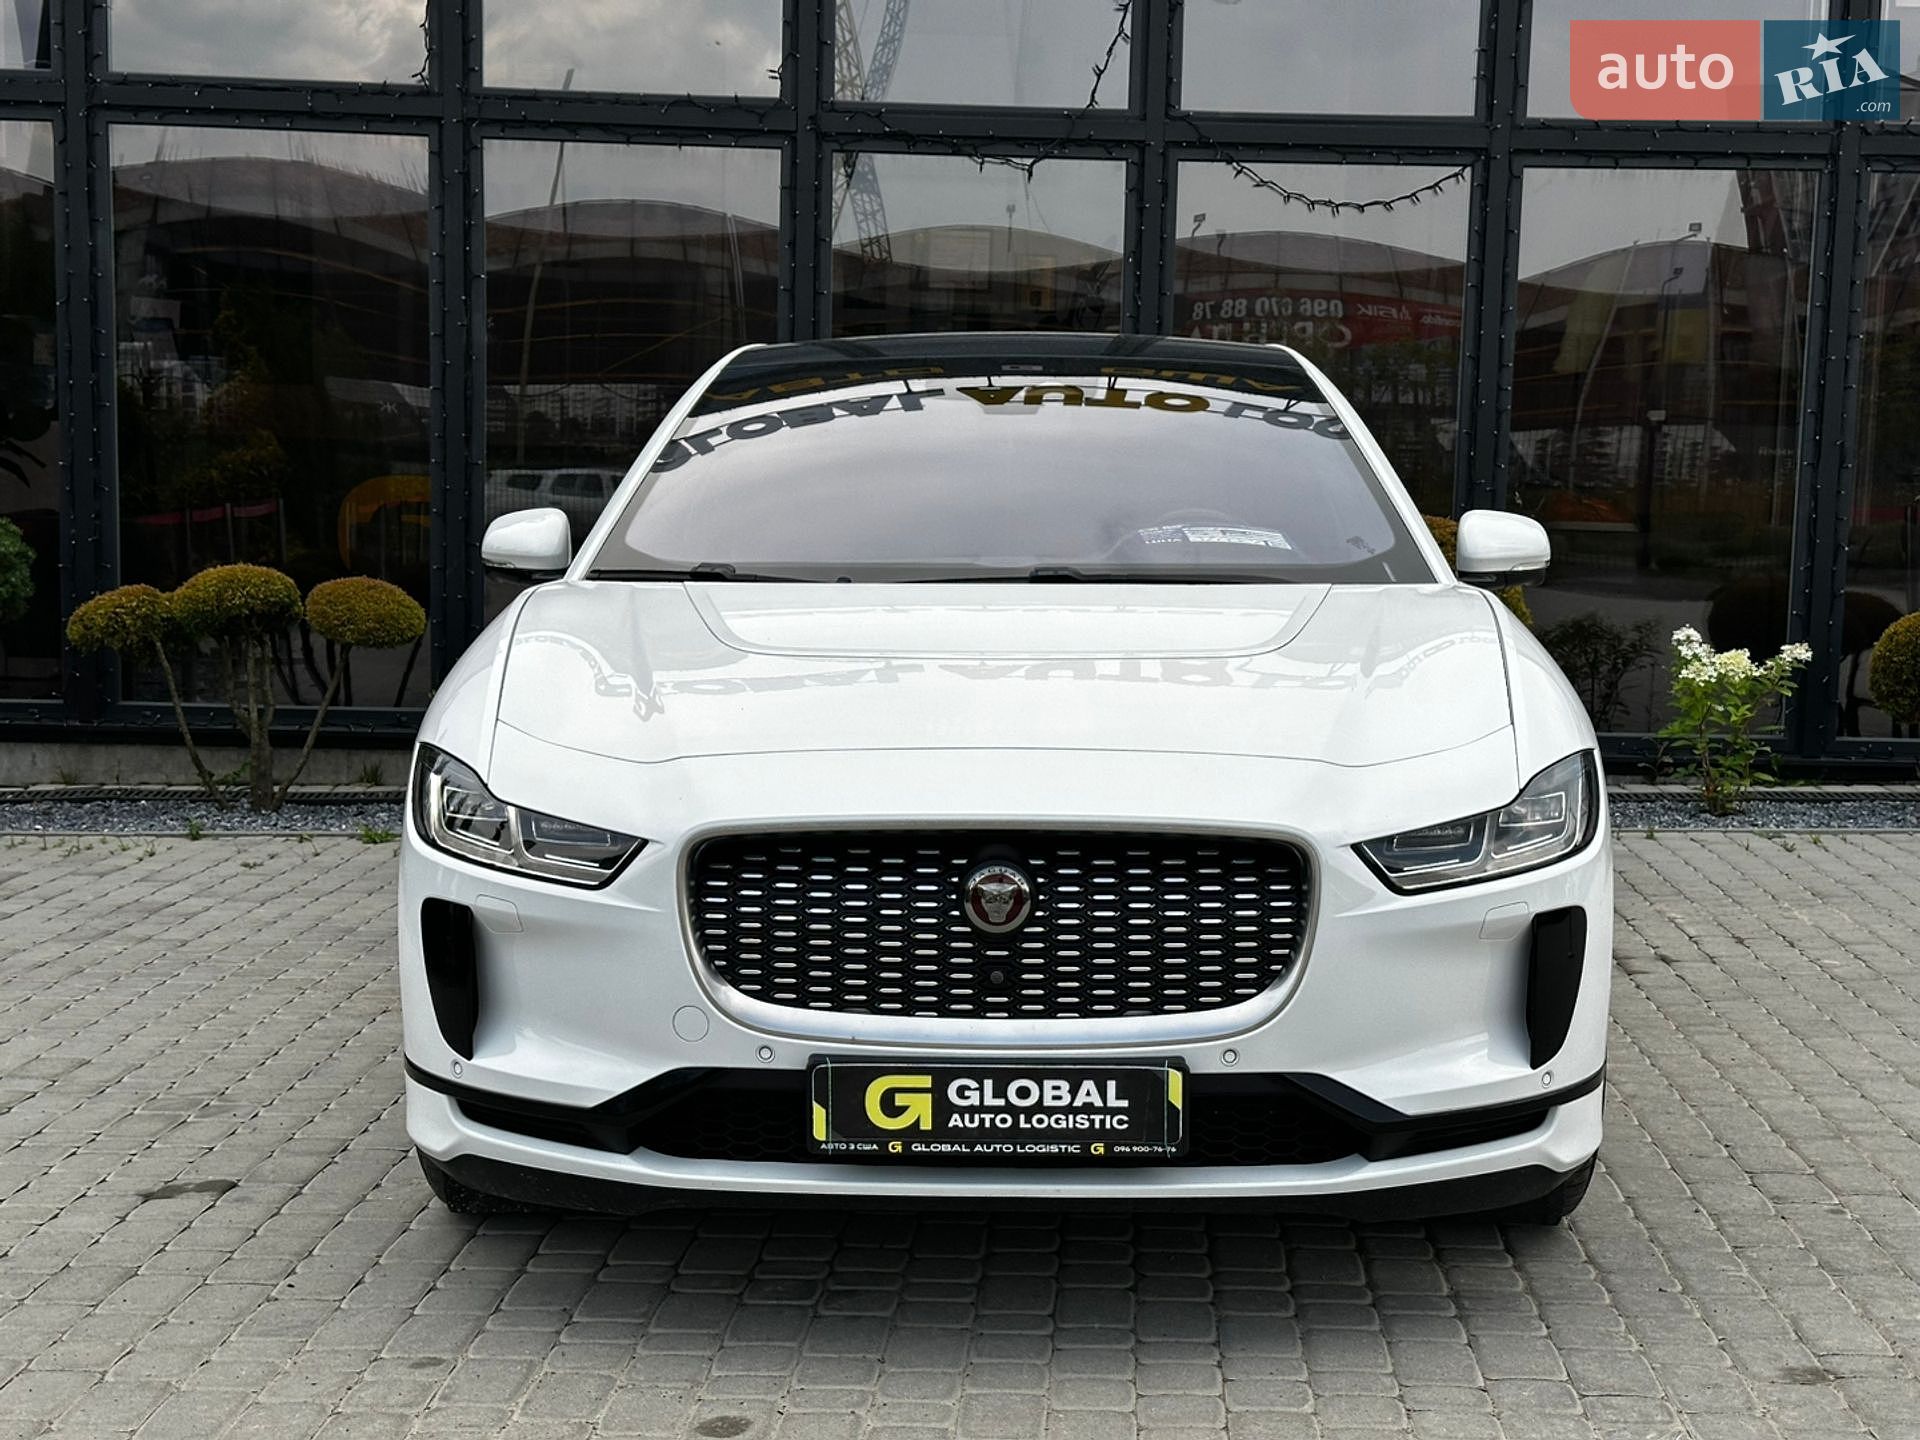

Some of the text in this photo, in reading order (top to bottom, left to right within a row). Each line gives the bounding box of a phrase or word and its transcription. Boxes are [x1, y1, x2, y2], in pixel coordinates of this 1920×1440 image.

[946, 1077, 1129, 1108] GLOBAL
[947, 1113, 1129, 1130] AUTO LOGISTIC
[911, 1143, 971, 1152] GLOBAL
[974, 1143, 1014, 1153] AUTO
[1016, 1144, 1081, 1153] LOGISTIC
